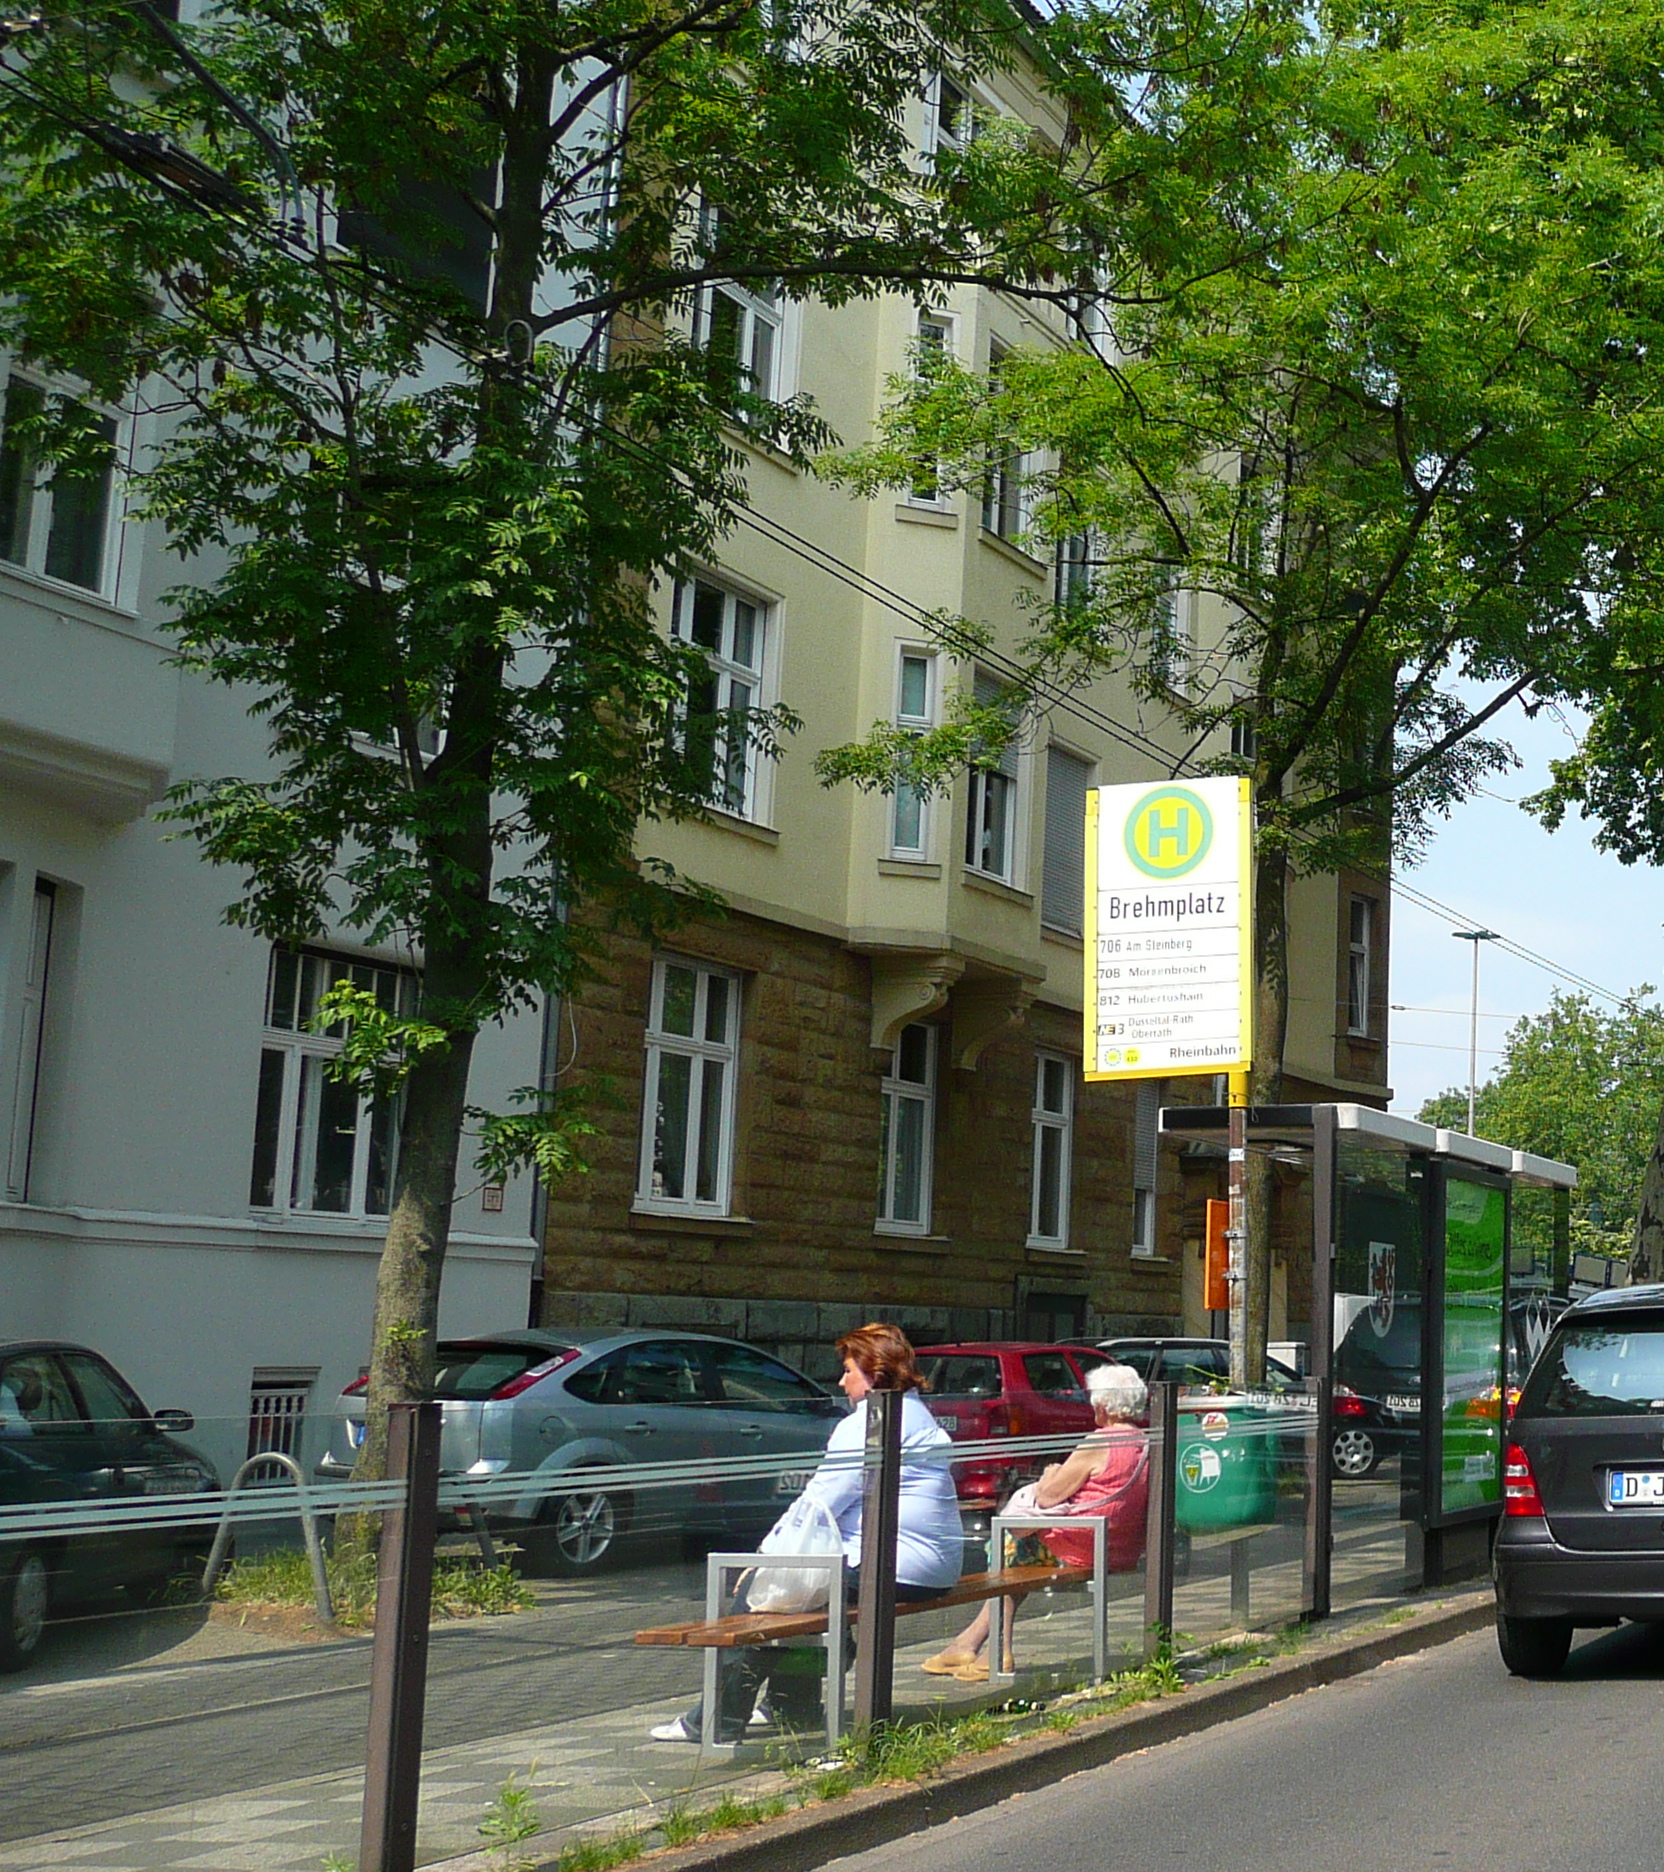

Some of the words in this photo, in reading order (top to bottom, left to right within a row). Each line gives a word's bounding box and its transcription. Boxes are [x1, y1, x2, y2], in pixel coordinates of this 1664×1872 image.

[1148, 807, 1189, 858] H
[1109, 892, 1225, 922] Brehmplatz
[1100, 939, 1121, 954] 706
[1126, 941, 1142, 952] Am
[1145, 938, 1193, 952] Steinberg
[1099, 995, 1121, 1006] 812
[1128, 992, 1203, 1006] Hubertushain
[1169, 1044, 1237, 1059] Rheinbahn
[1625, 1477, 1638, 1497] D
